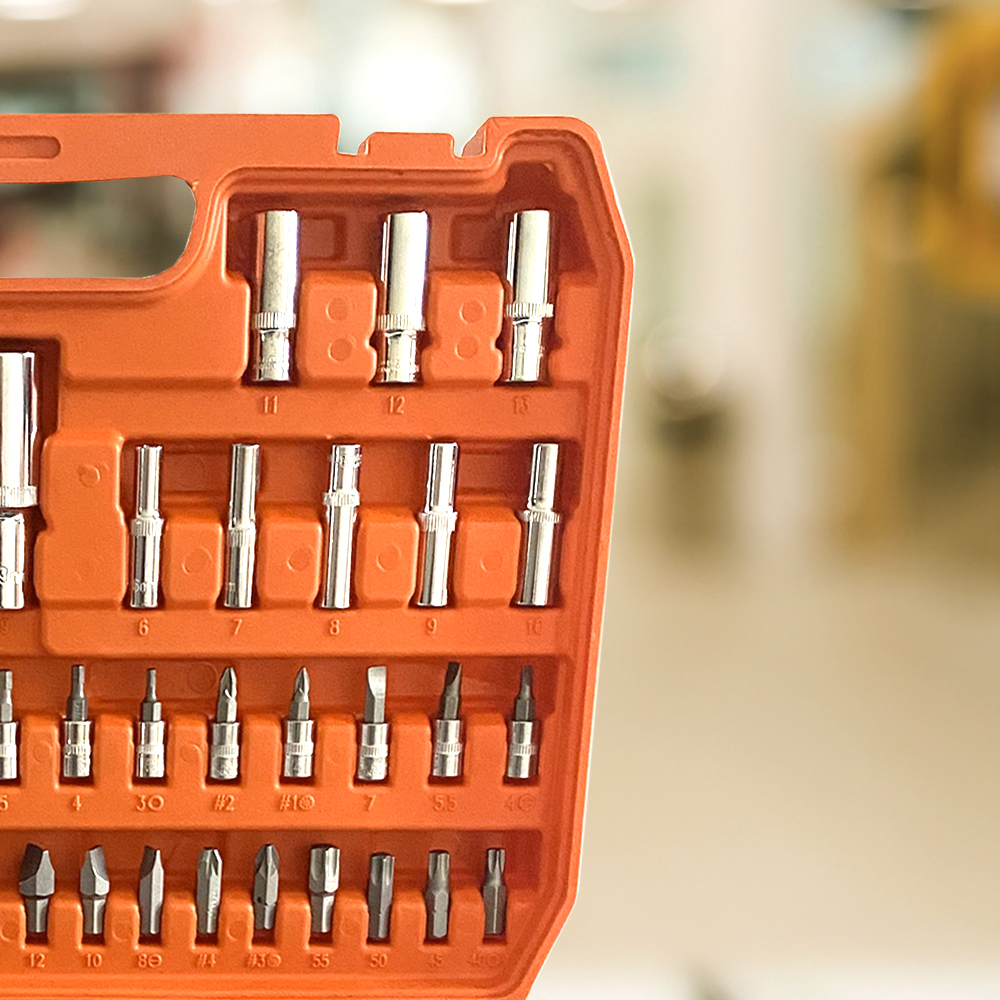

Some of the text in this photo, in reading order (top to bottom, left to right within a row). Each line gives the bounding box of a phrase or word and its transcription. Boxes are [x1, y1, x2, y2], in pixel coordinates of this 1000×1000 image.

[262, 396, 279, 414] 11
[388, 396, 406, 414] 12
[138, 618, 150, 636] 6
[232, 618, 243, 636] 7
[328, 619, 340, 636] 8
[426, 618, 438, 635] 9
[72, 795, 82, 811] 4
[214, 794, 236, 811] #2
[366, 795, 376, 811] 7
[29, 953, 46, 968] 12
[86, 953, 103, 968] 10
[196, 953, 217, 968] #4
[312, 953, 331, 968] 55
[369, 953, 388, 968] 50
